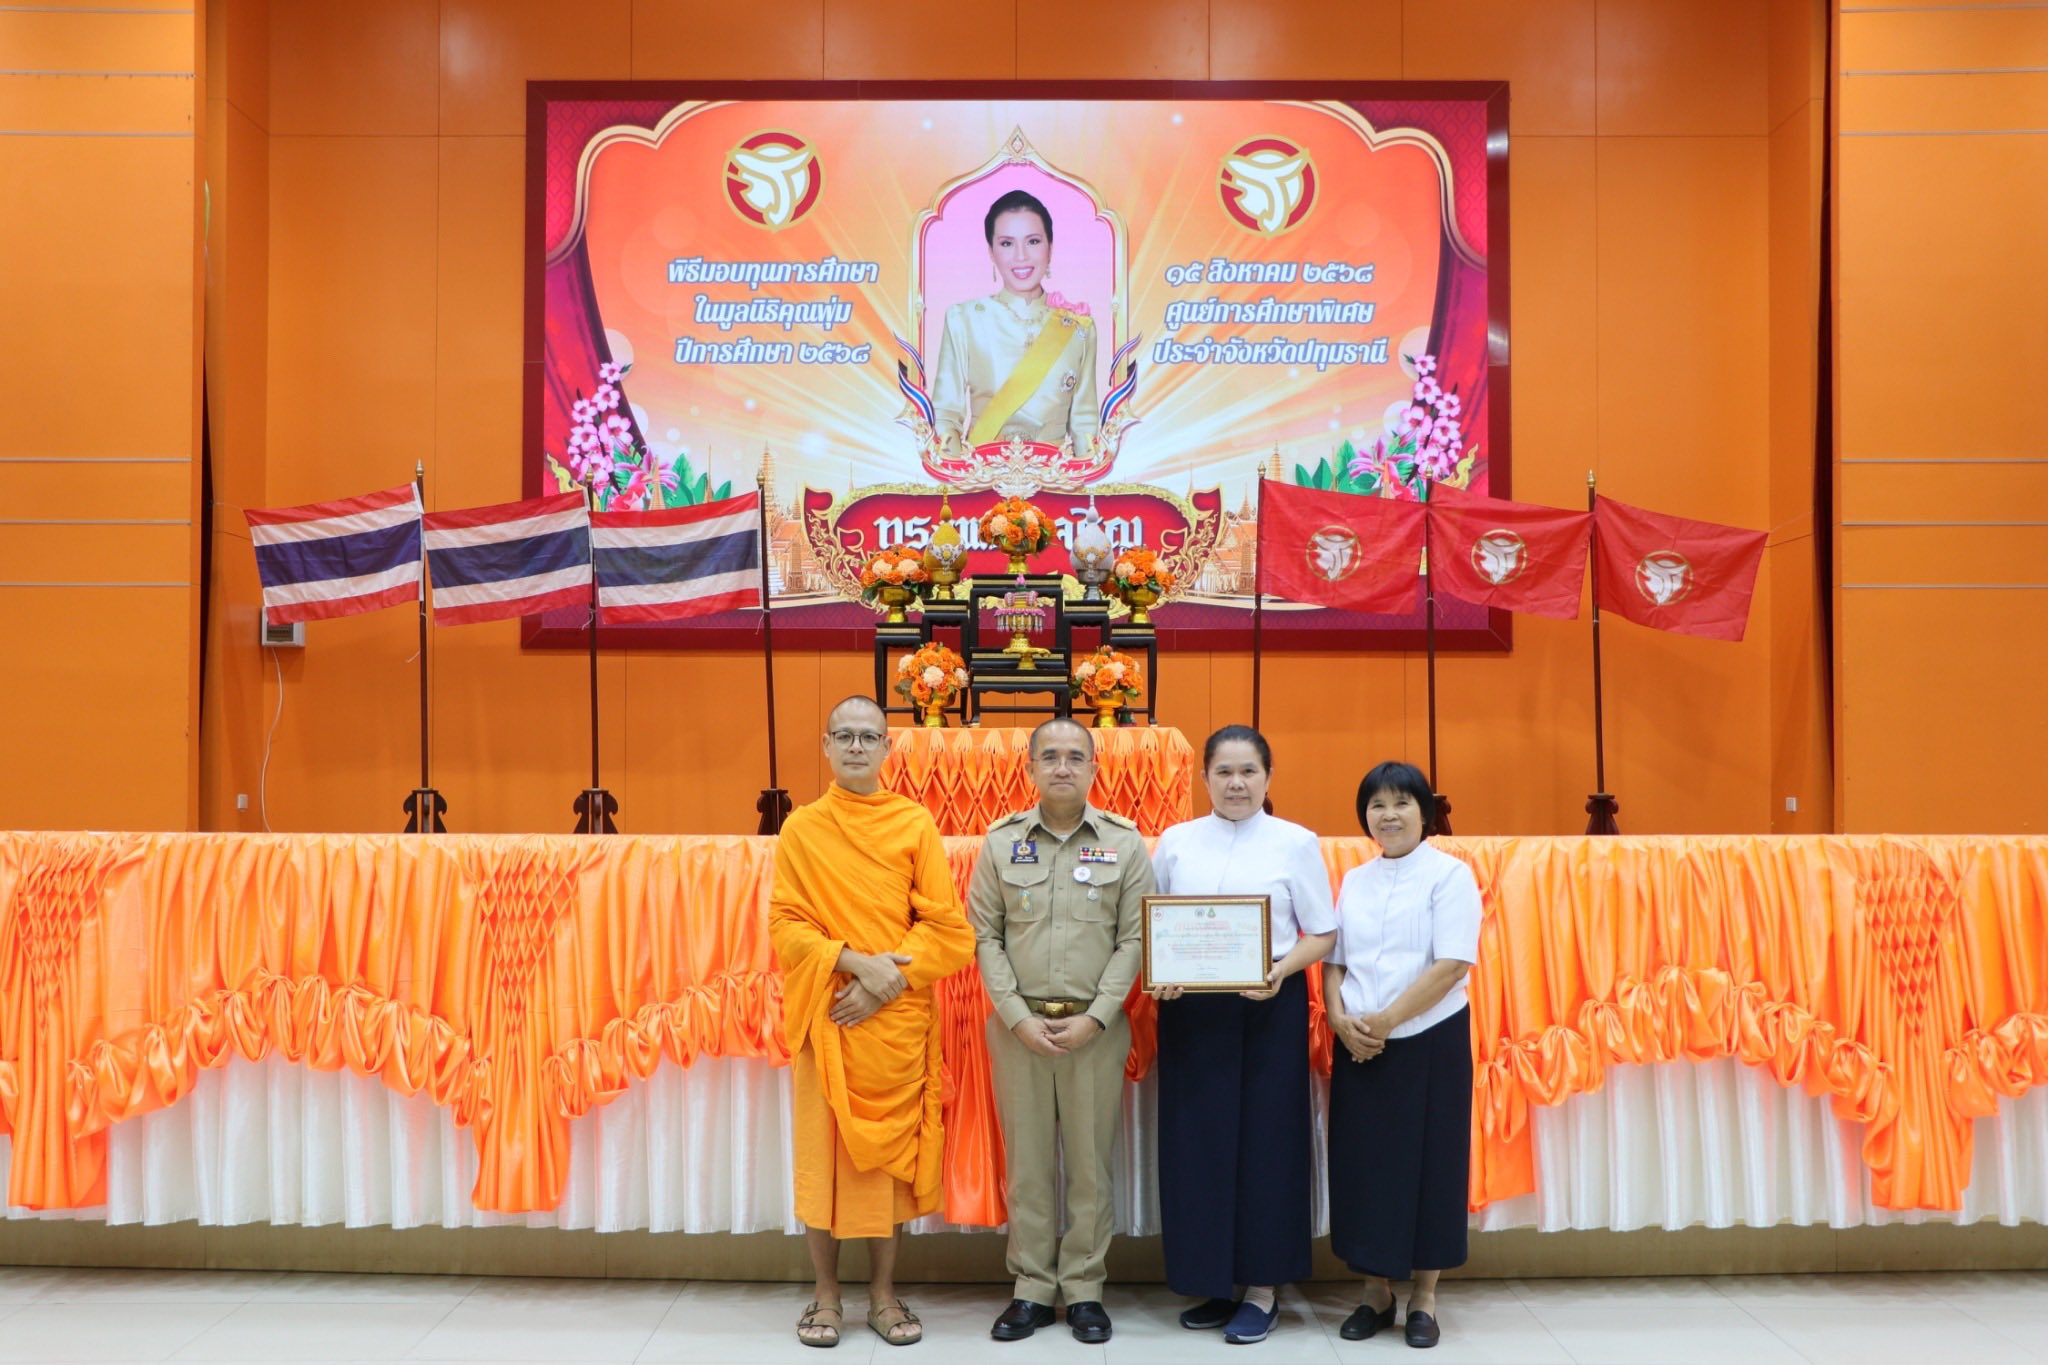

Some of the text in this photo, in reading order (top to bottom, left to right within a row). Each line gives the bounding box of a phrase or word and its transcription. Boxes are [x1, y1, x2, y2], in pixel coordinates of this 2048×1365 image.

[668, 256, 879, 290] พิธีมอบทุนการศึกษา
[1165, 257, 1375, 287] ๑๕ สิงหาคม ๒๕๖๘
[694, 294, 852, 330] ในมูลนิธิคุณพุ่ม
[1164, 296, 1376, 331] ศูนย์การศึกษาพิเศษ
[675, 337, 872, 364] ปีการศึกษา ๒๕๖๘
[1152, 336, 1390, 372] ประจำจังหวัดปทุมธานี
